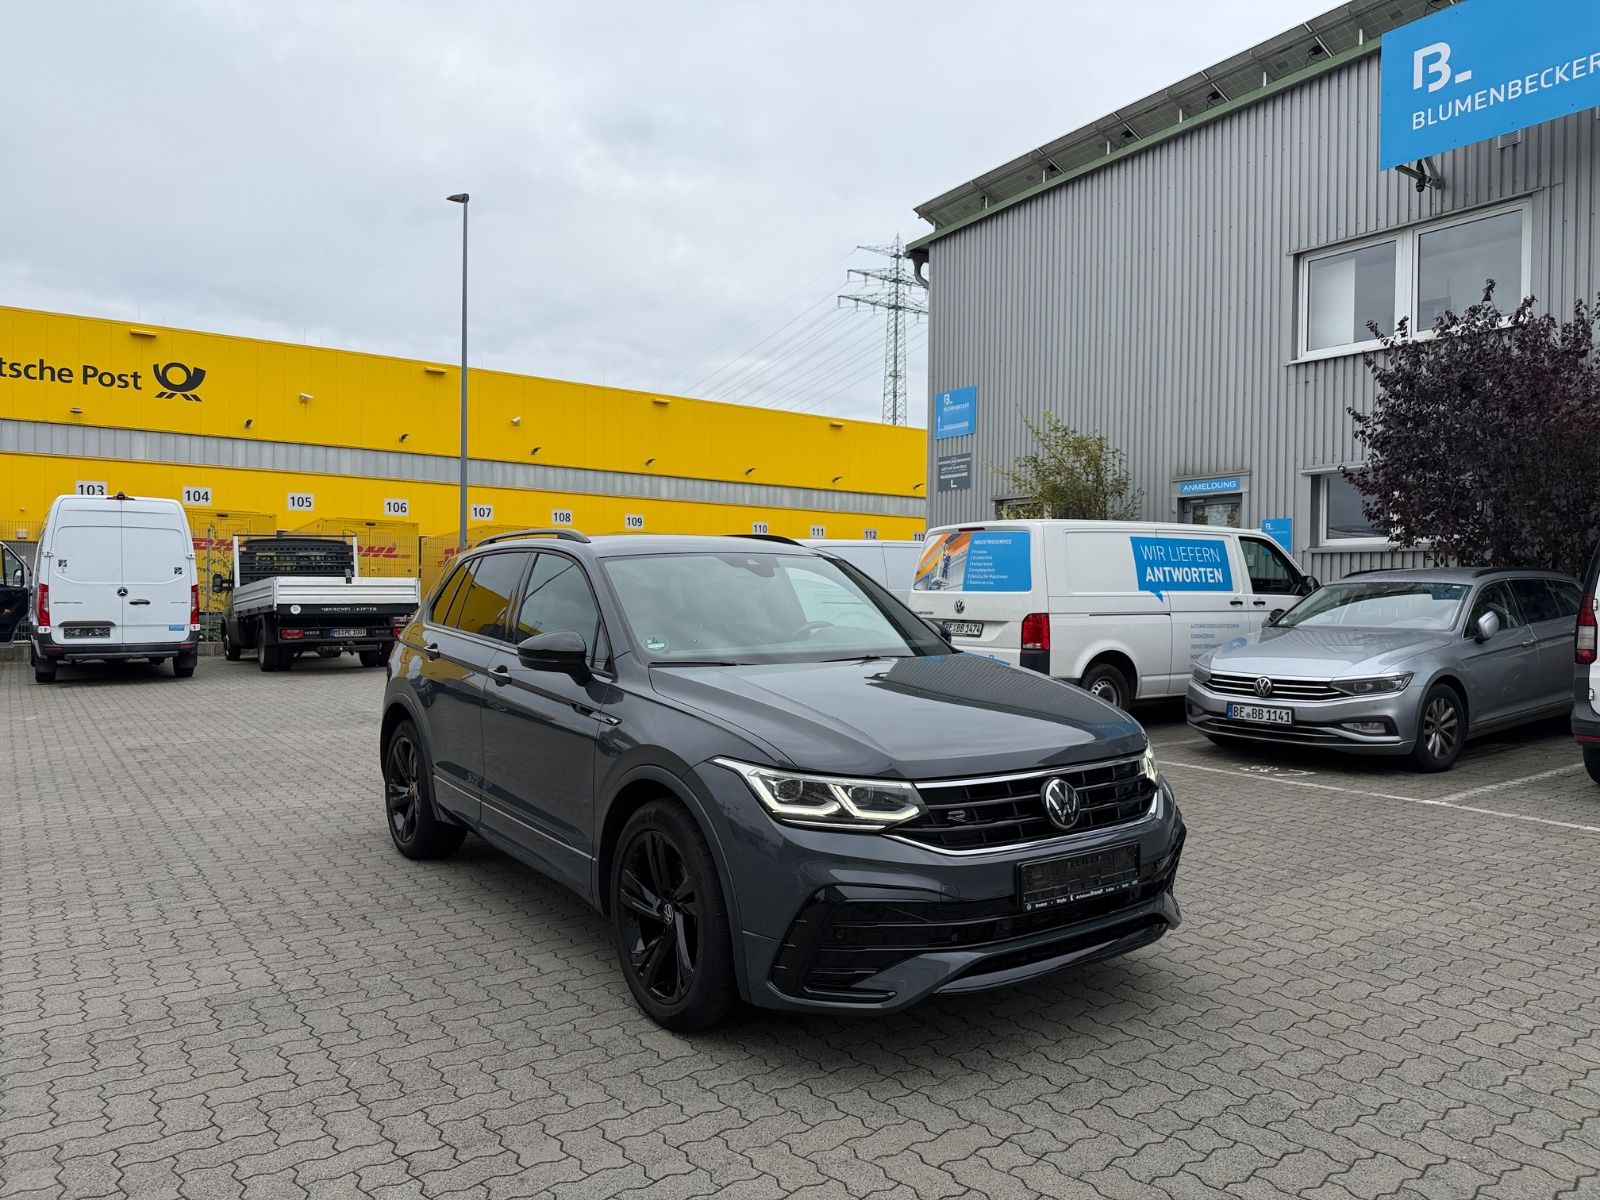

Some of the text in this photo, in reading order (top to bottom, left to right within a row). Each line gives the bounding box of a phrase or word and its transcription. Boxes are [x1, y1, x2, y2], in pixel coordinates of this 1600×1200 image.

[1412, 51, 1600, 130] BLUMENBECKER
[0, 357, 143, 390] tsche Post
[78, 484, 105, 495] 103
[1183, 480, 1237, 492] ANMELDUNG
[185, 490, 210, 502] 104
[289, 496, 312, 508] 105
[386, 502, 407, 513] 106
[473, 507, 492, 518] 107
[553, 512, 571, 523] 108
[626, 517, 643, 527] 109
[753, 524, 768, 534] 110
[811, 528, 825, 537] 111
[864, 531, 877, 539] 112
[914, 533, 925, 541] 113
[1140, 544, 1221, 563] WIR LIEFERN
[1145, 566, 1224, 583] ANTWORTEN
[965, 624, 981, 634] 1474
[1233, 706, 1291, 723] BE BB 1141
